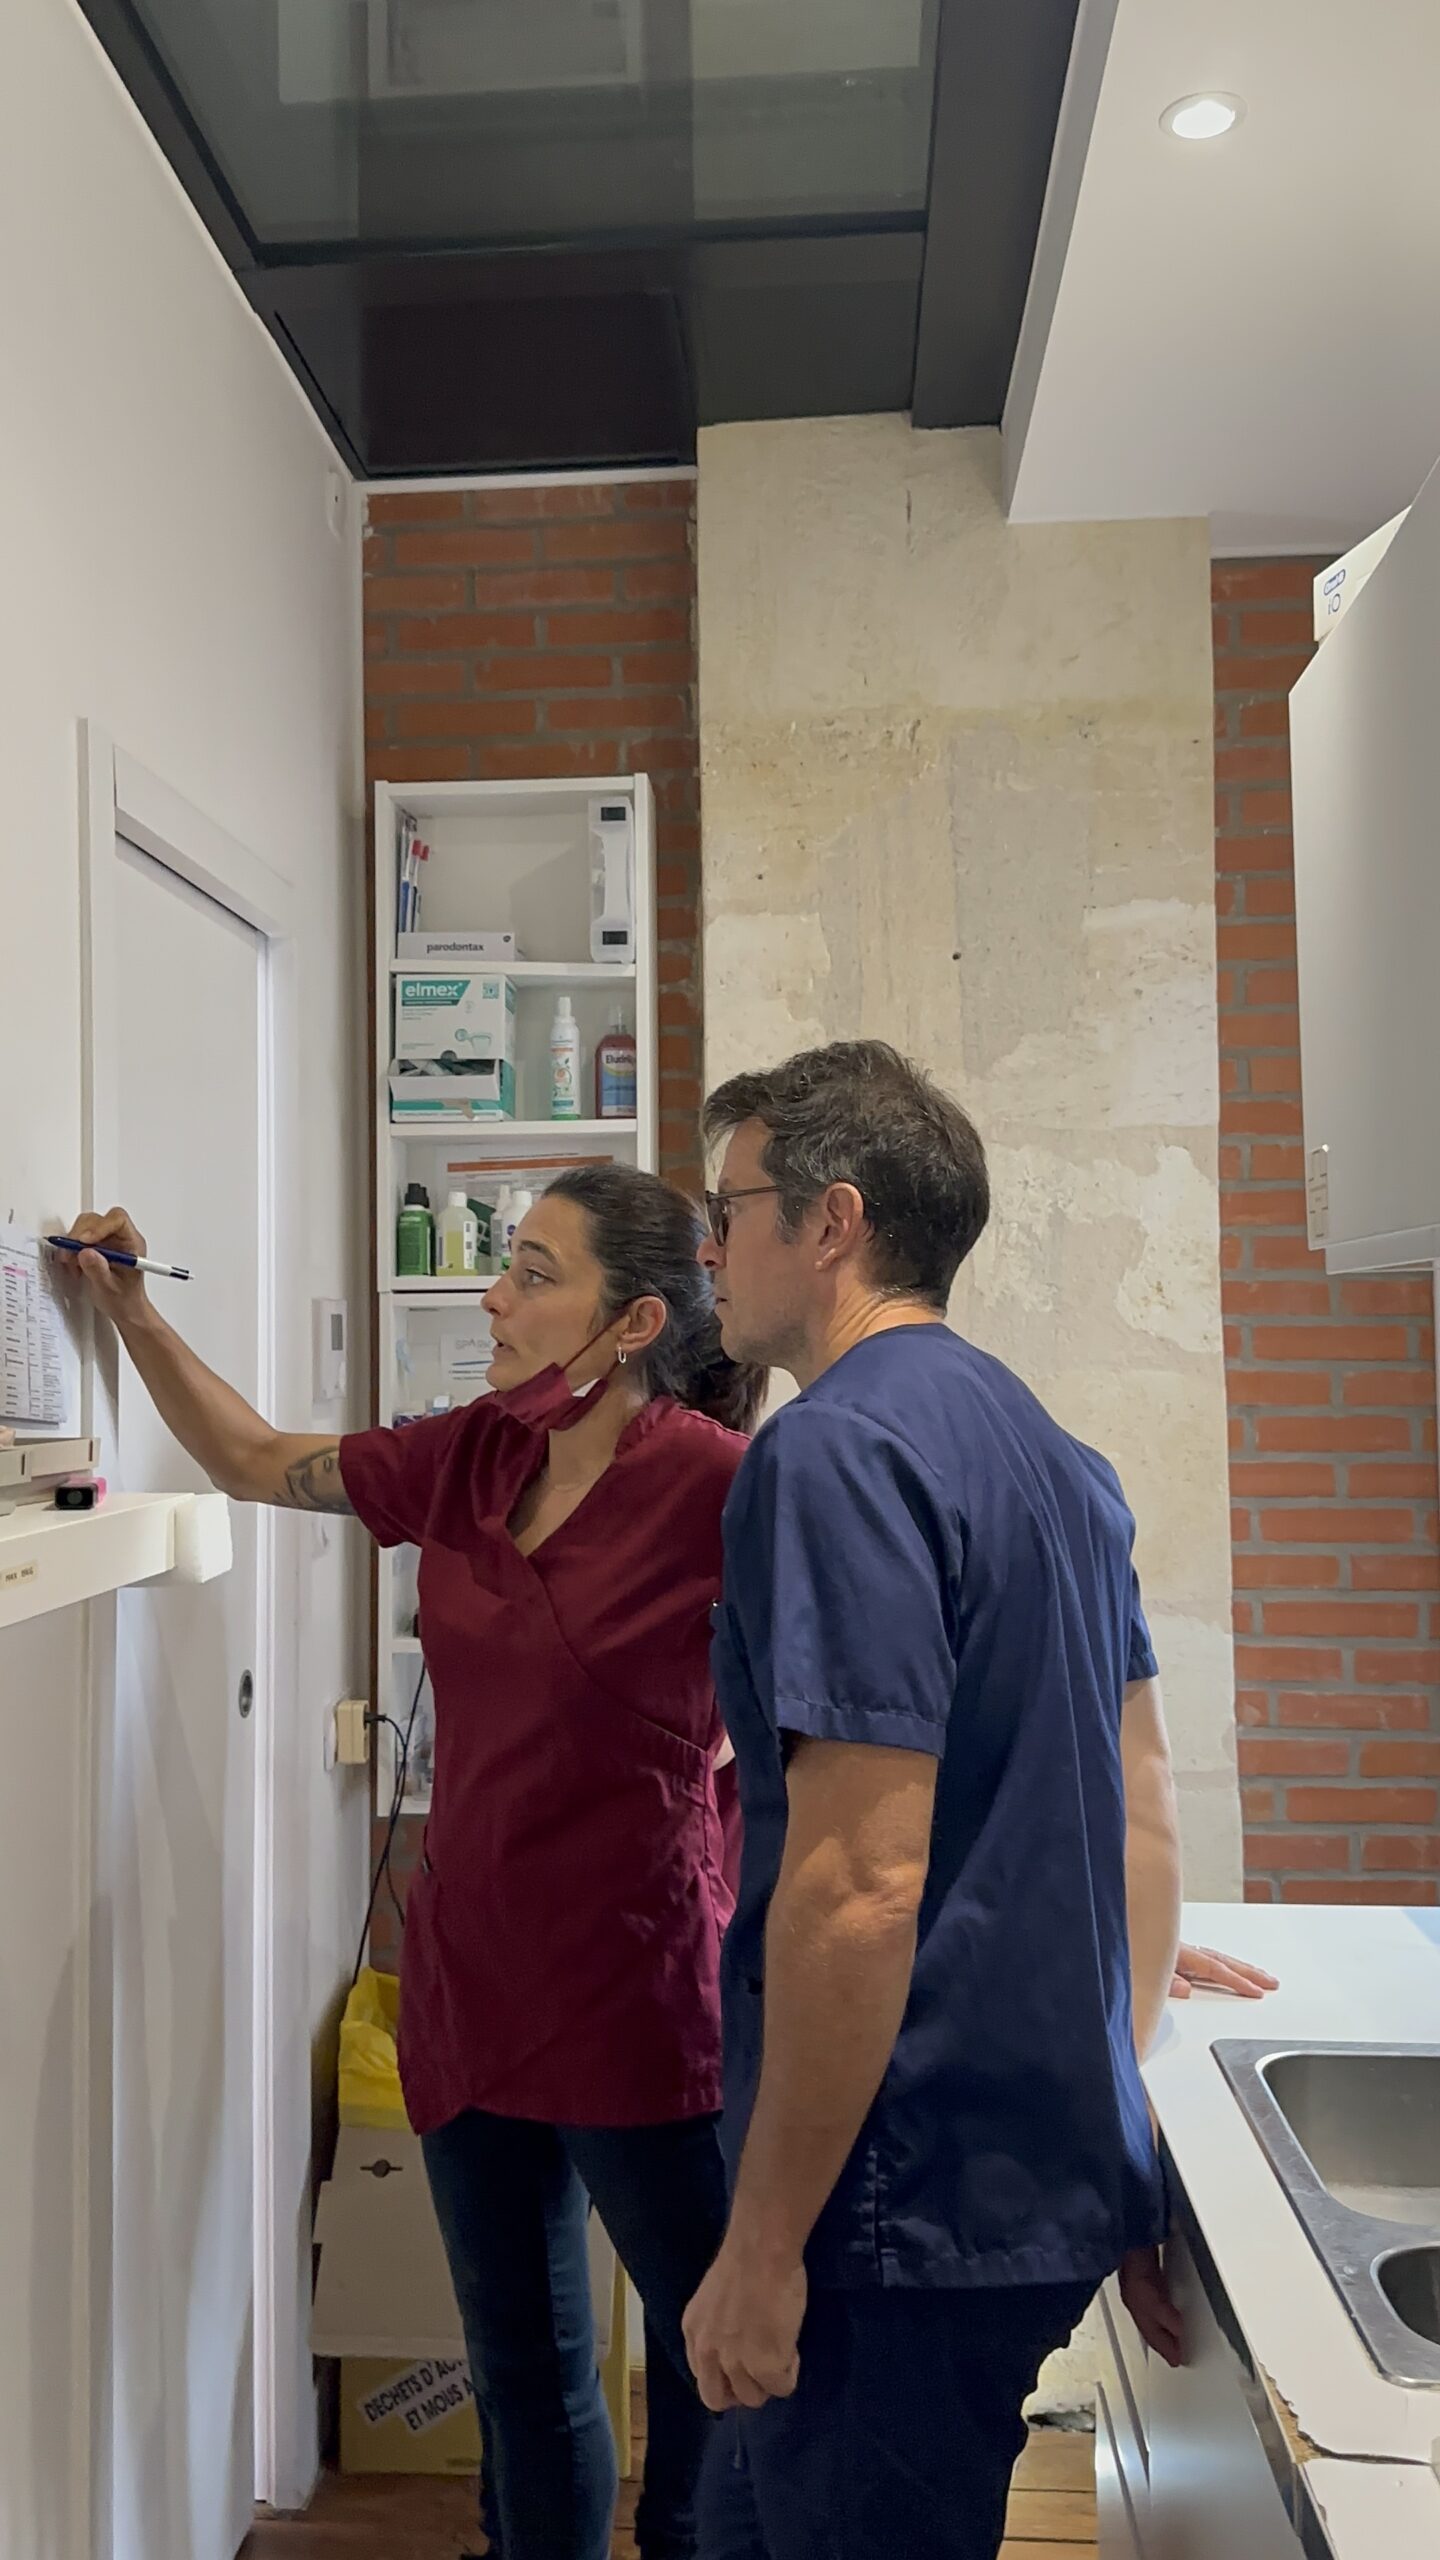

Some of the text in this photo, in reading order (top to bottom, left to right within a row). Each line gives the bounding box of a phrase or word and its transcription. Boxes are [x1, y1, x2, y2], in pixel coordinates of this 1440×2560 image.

[426, 941, 484, 954] parodontax
[404, 981, 460, 997] elmex
[364, 2374, 423, 2422] DECHETS
[405, 2406, 424, 2431] ET
[421, 2383, 464, 2420] MOUS
